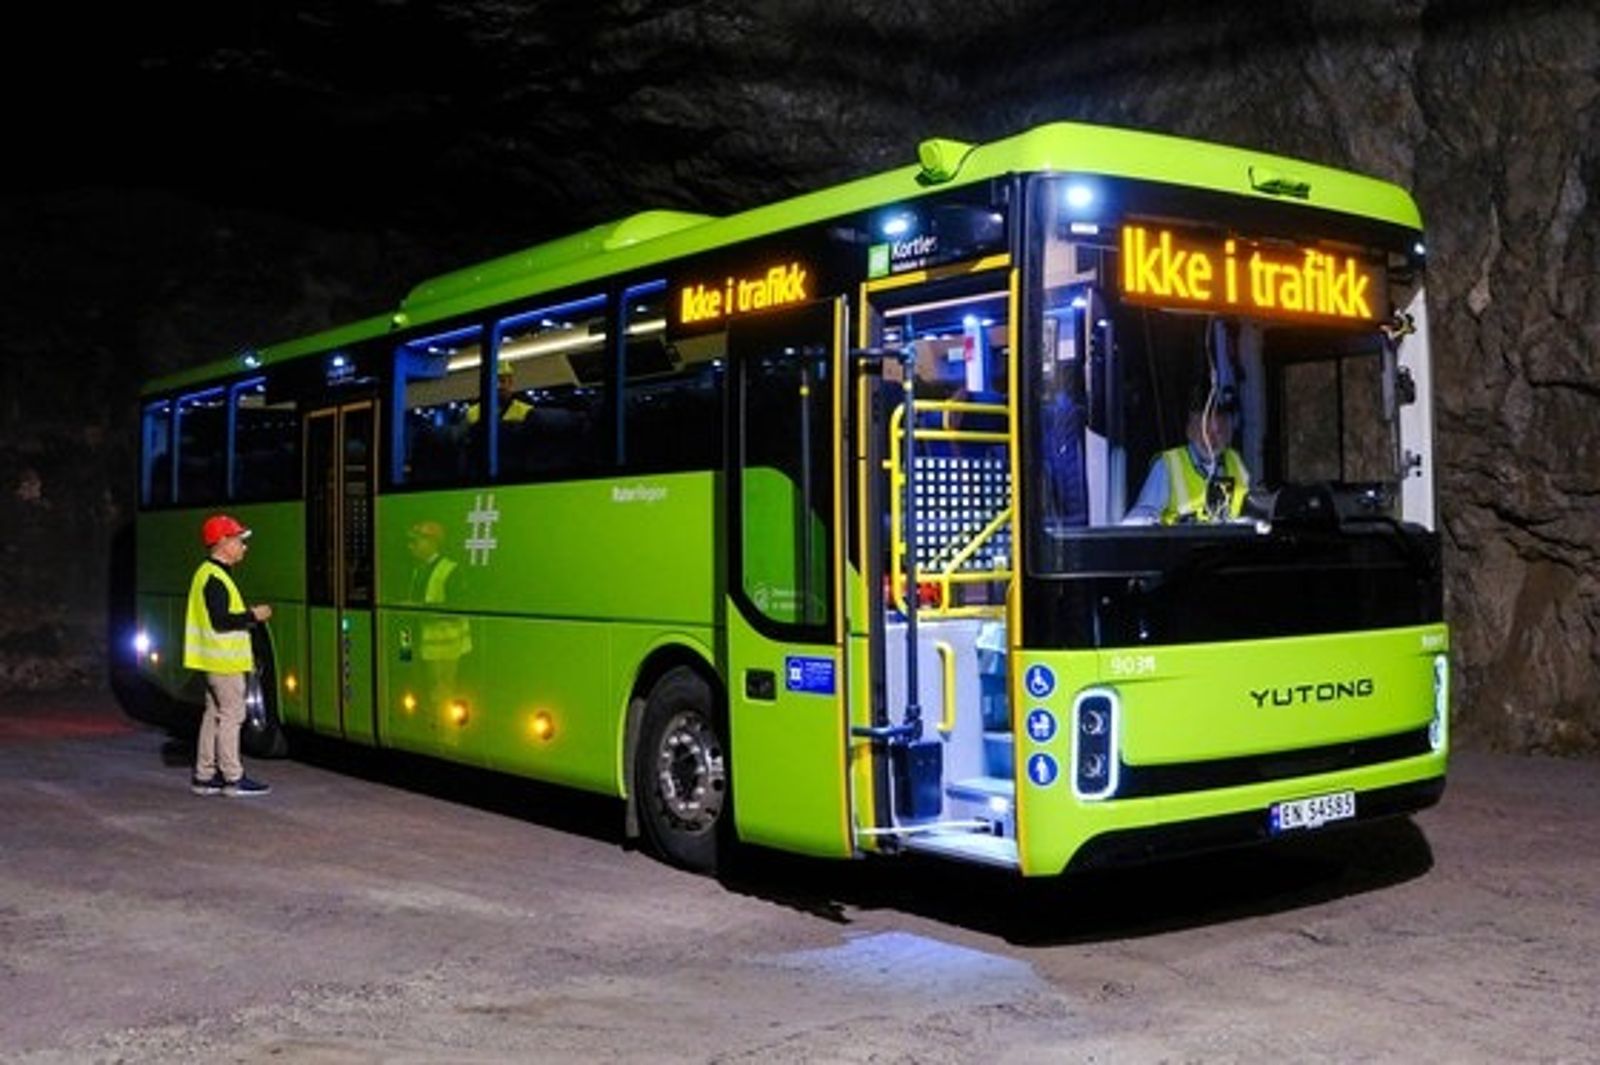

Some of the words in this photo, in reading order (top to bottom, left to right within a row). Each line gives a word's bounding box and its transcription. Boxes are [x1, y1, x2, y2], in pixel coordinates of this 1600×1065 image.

[681, 284, 721, 323] Ikke
[725, 277, 733, 314] i
[738, 262, 807, 312] trafikk
[1123, 226, 1212, 300] Ikke
[1225, 239, 1237, 303] i
[1250, 248, 1372, 318] trafikk
[1250, 679, 1373, 708] YUTONG
[1282, 804, 1303, 826] EN
